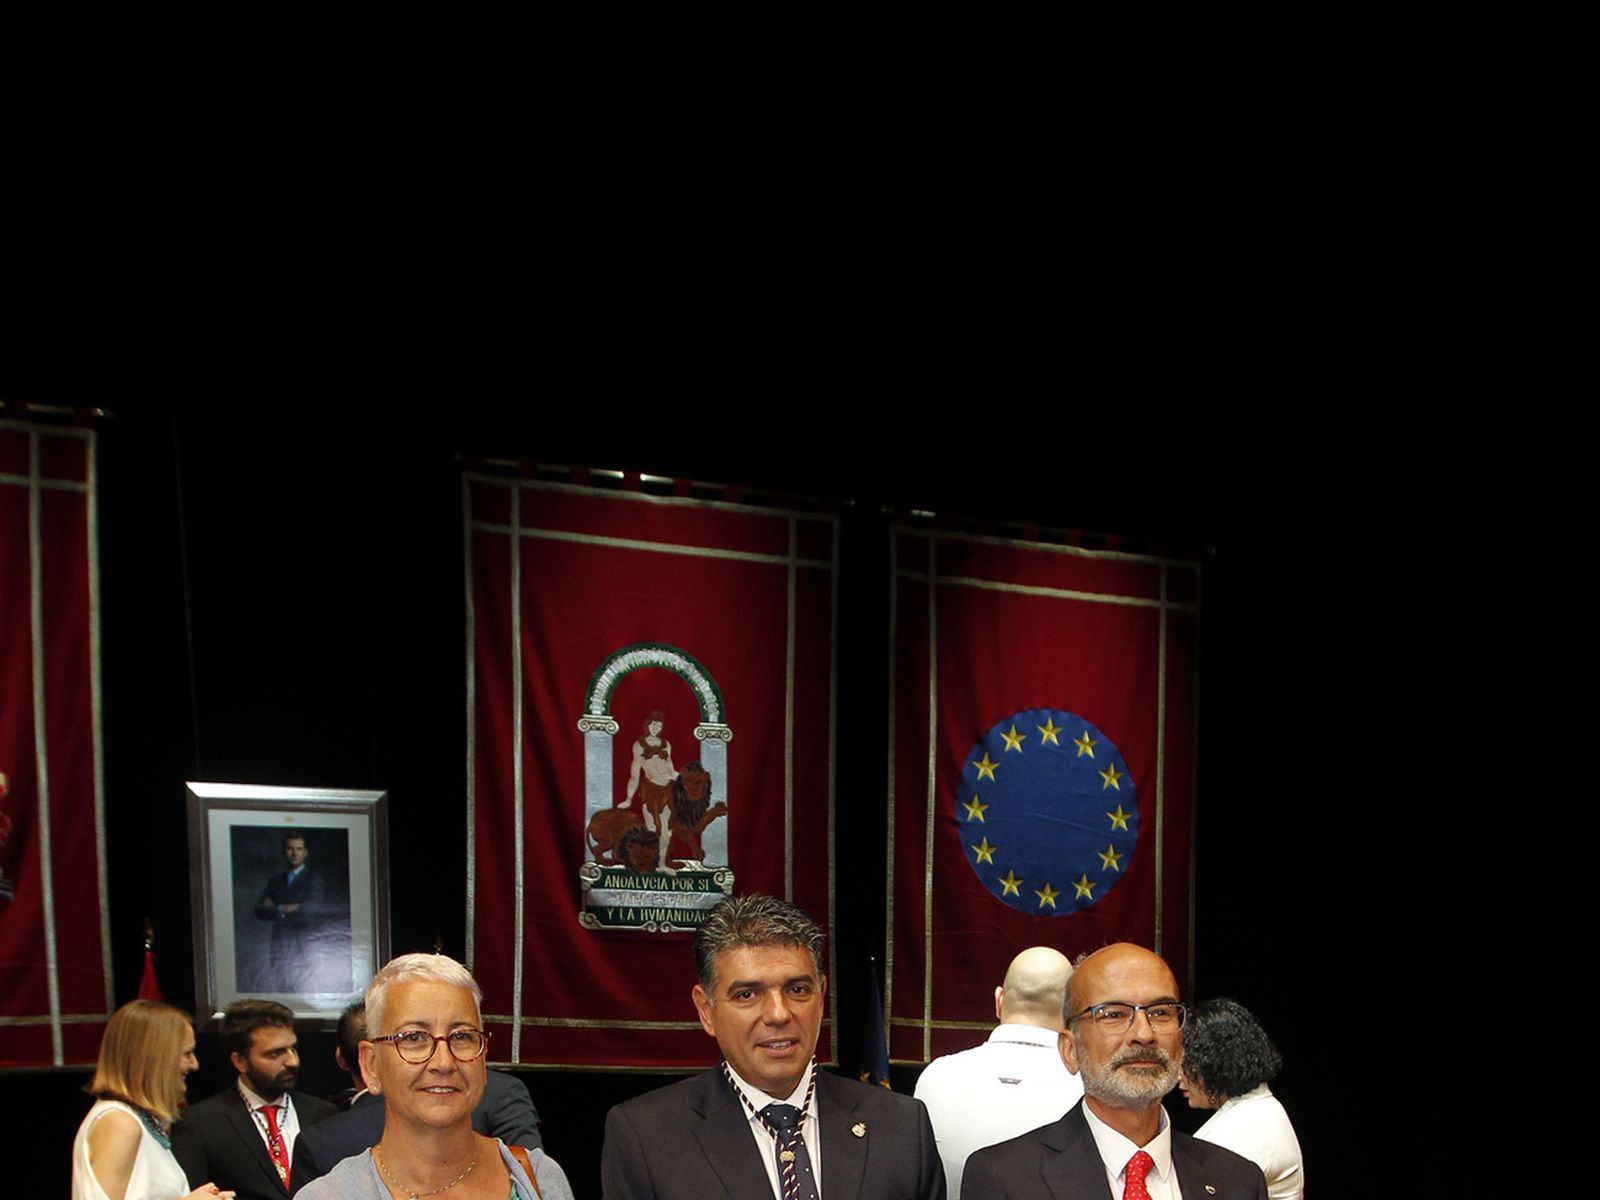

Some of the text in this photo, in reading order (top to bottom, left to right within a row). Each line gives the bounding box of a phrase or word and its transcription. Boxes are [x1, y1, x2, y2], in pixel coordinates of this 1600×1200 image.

[604, 874, 709, 891] ANDALVCIA POR SI
[607, 908, 614, 920] Y
[620, 908, 635, 920] LA
